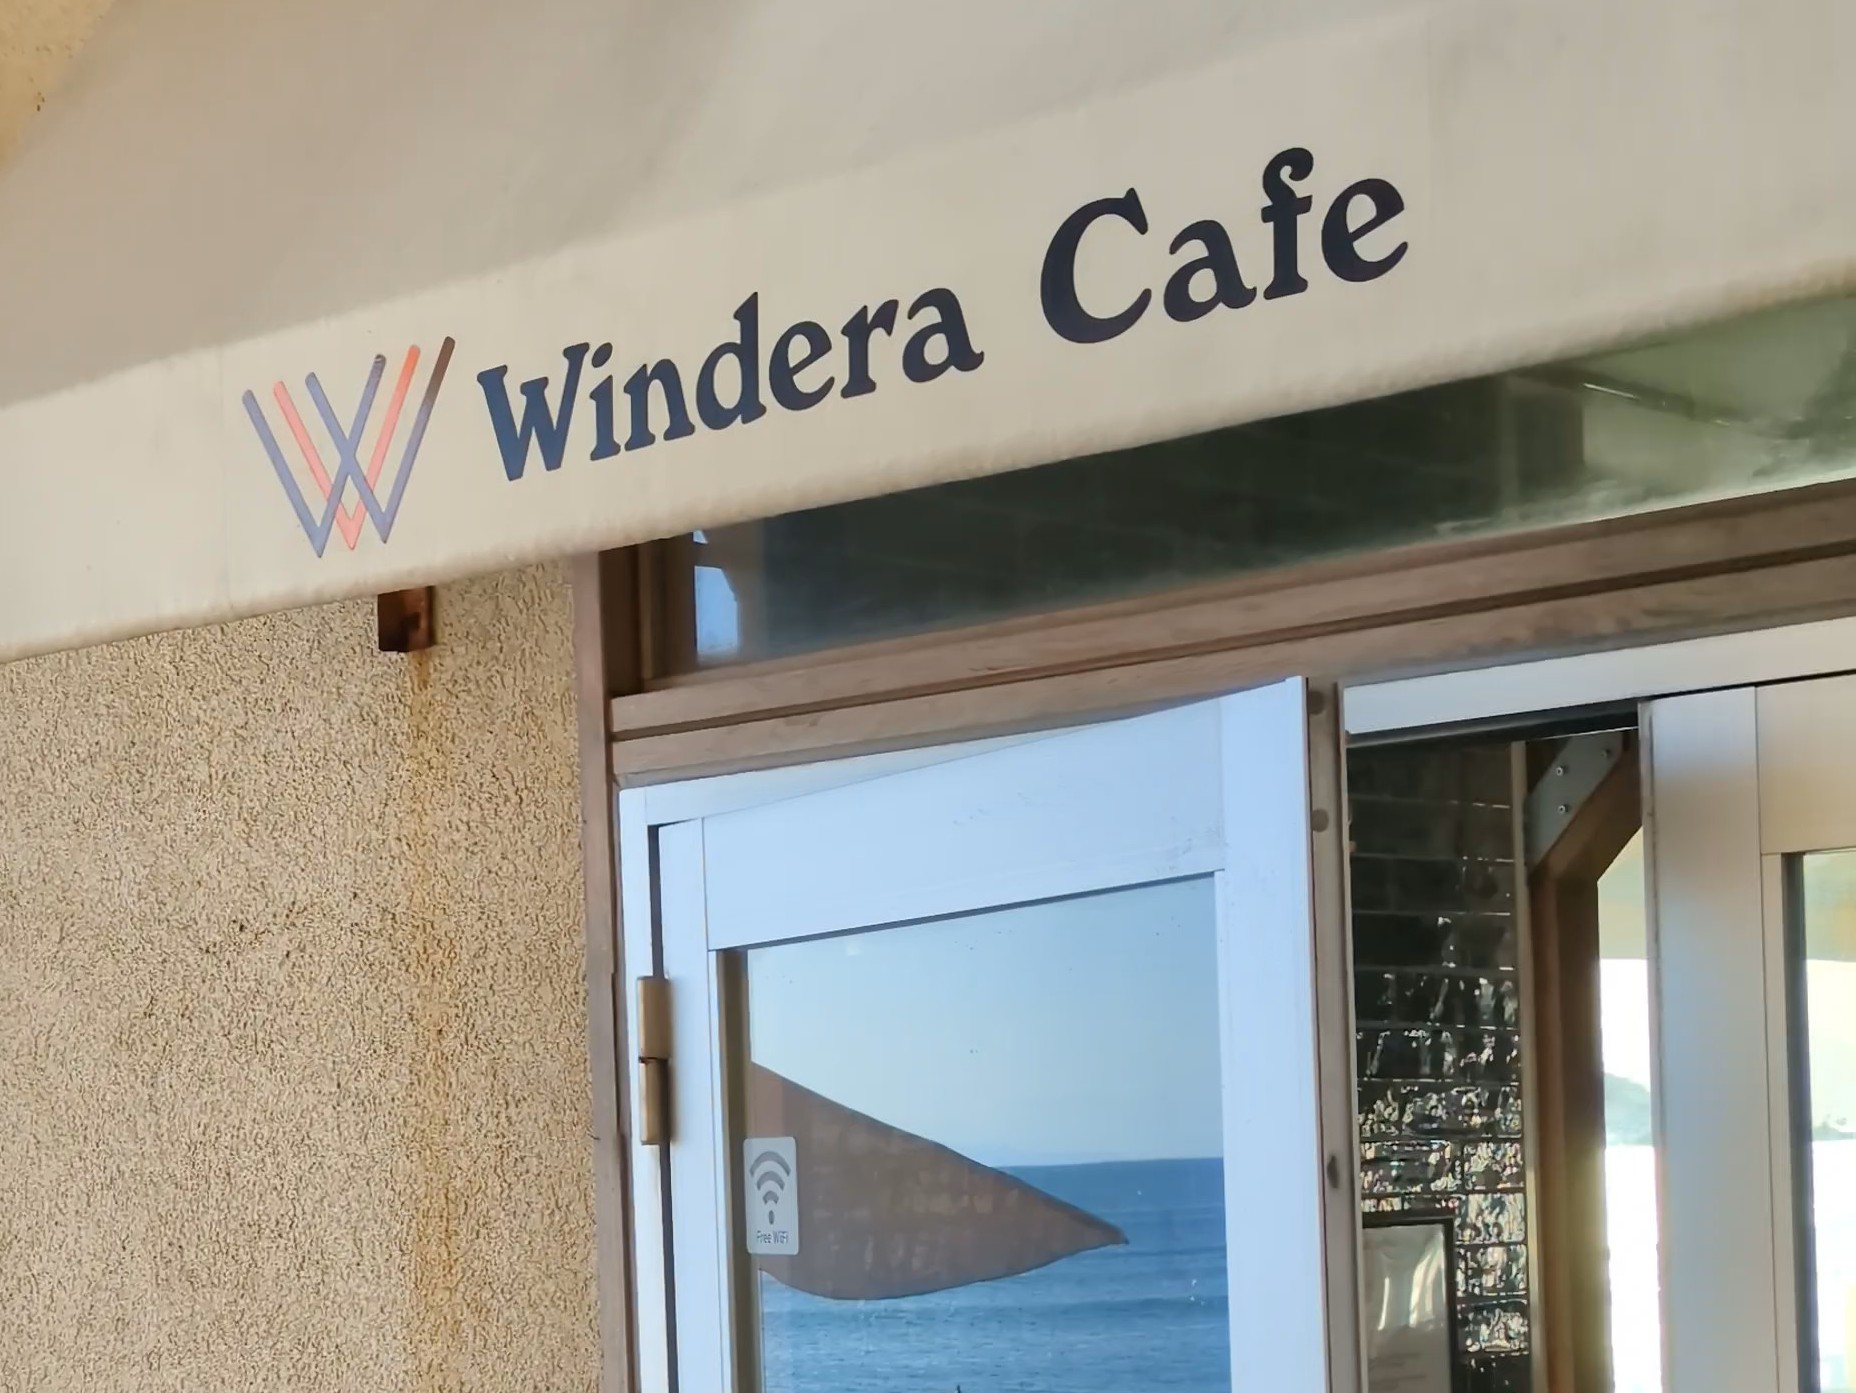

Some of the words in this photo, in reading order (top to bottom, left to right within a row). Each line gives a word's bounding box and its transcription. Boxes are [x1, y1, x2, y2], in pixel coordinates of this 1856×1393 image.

[477, 288, 985, 482] Windera
[1040, 147, 1409, 344] Cafe
[756, 1230, 771, 1244] Free
